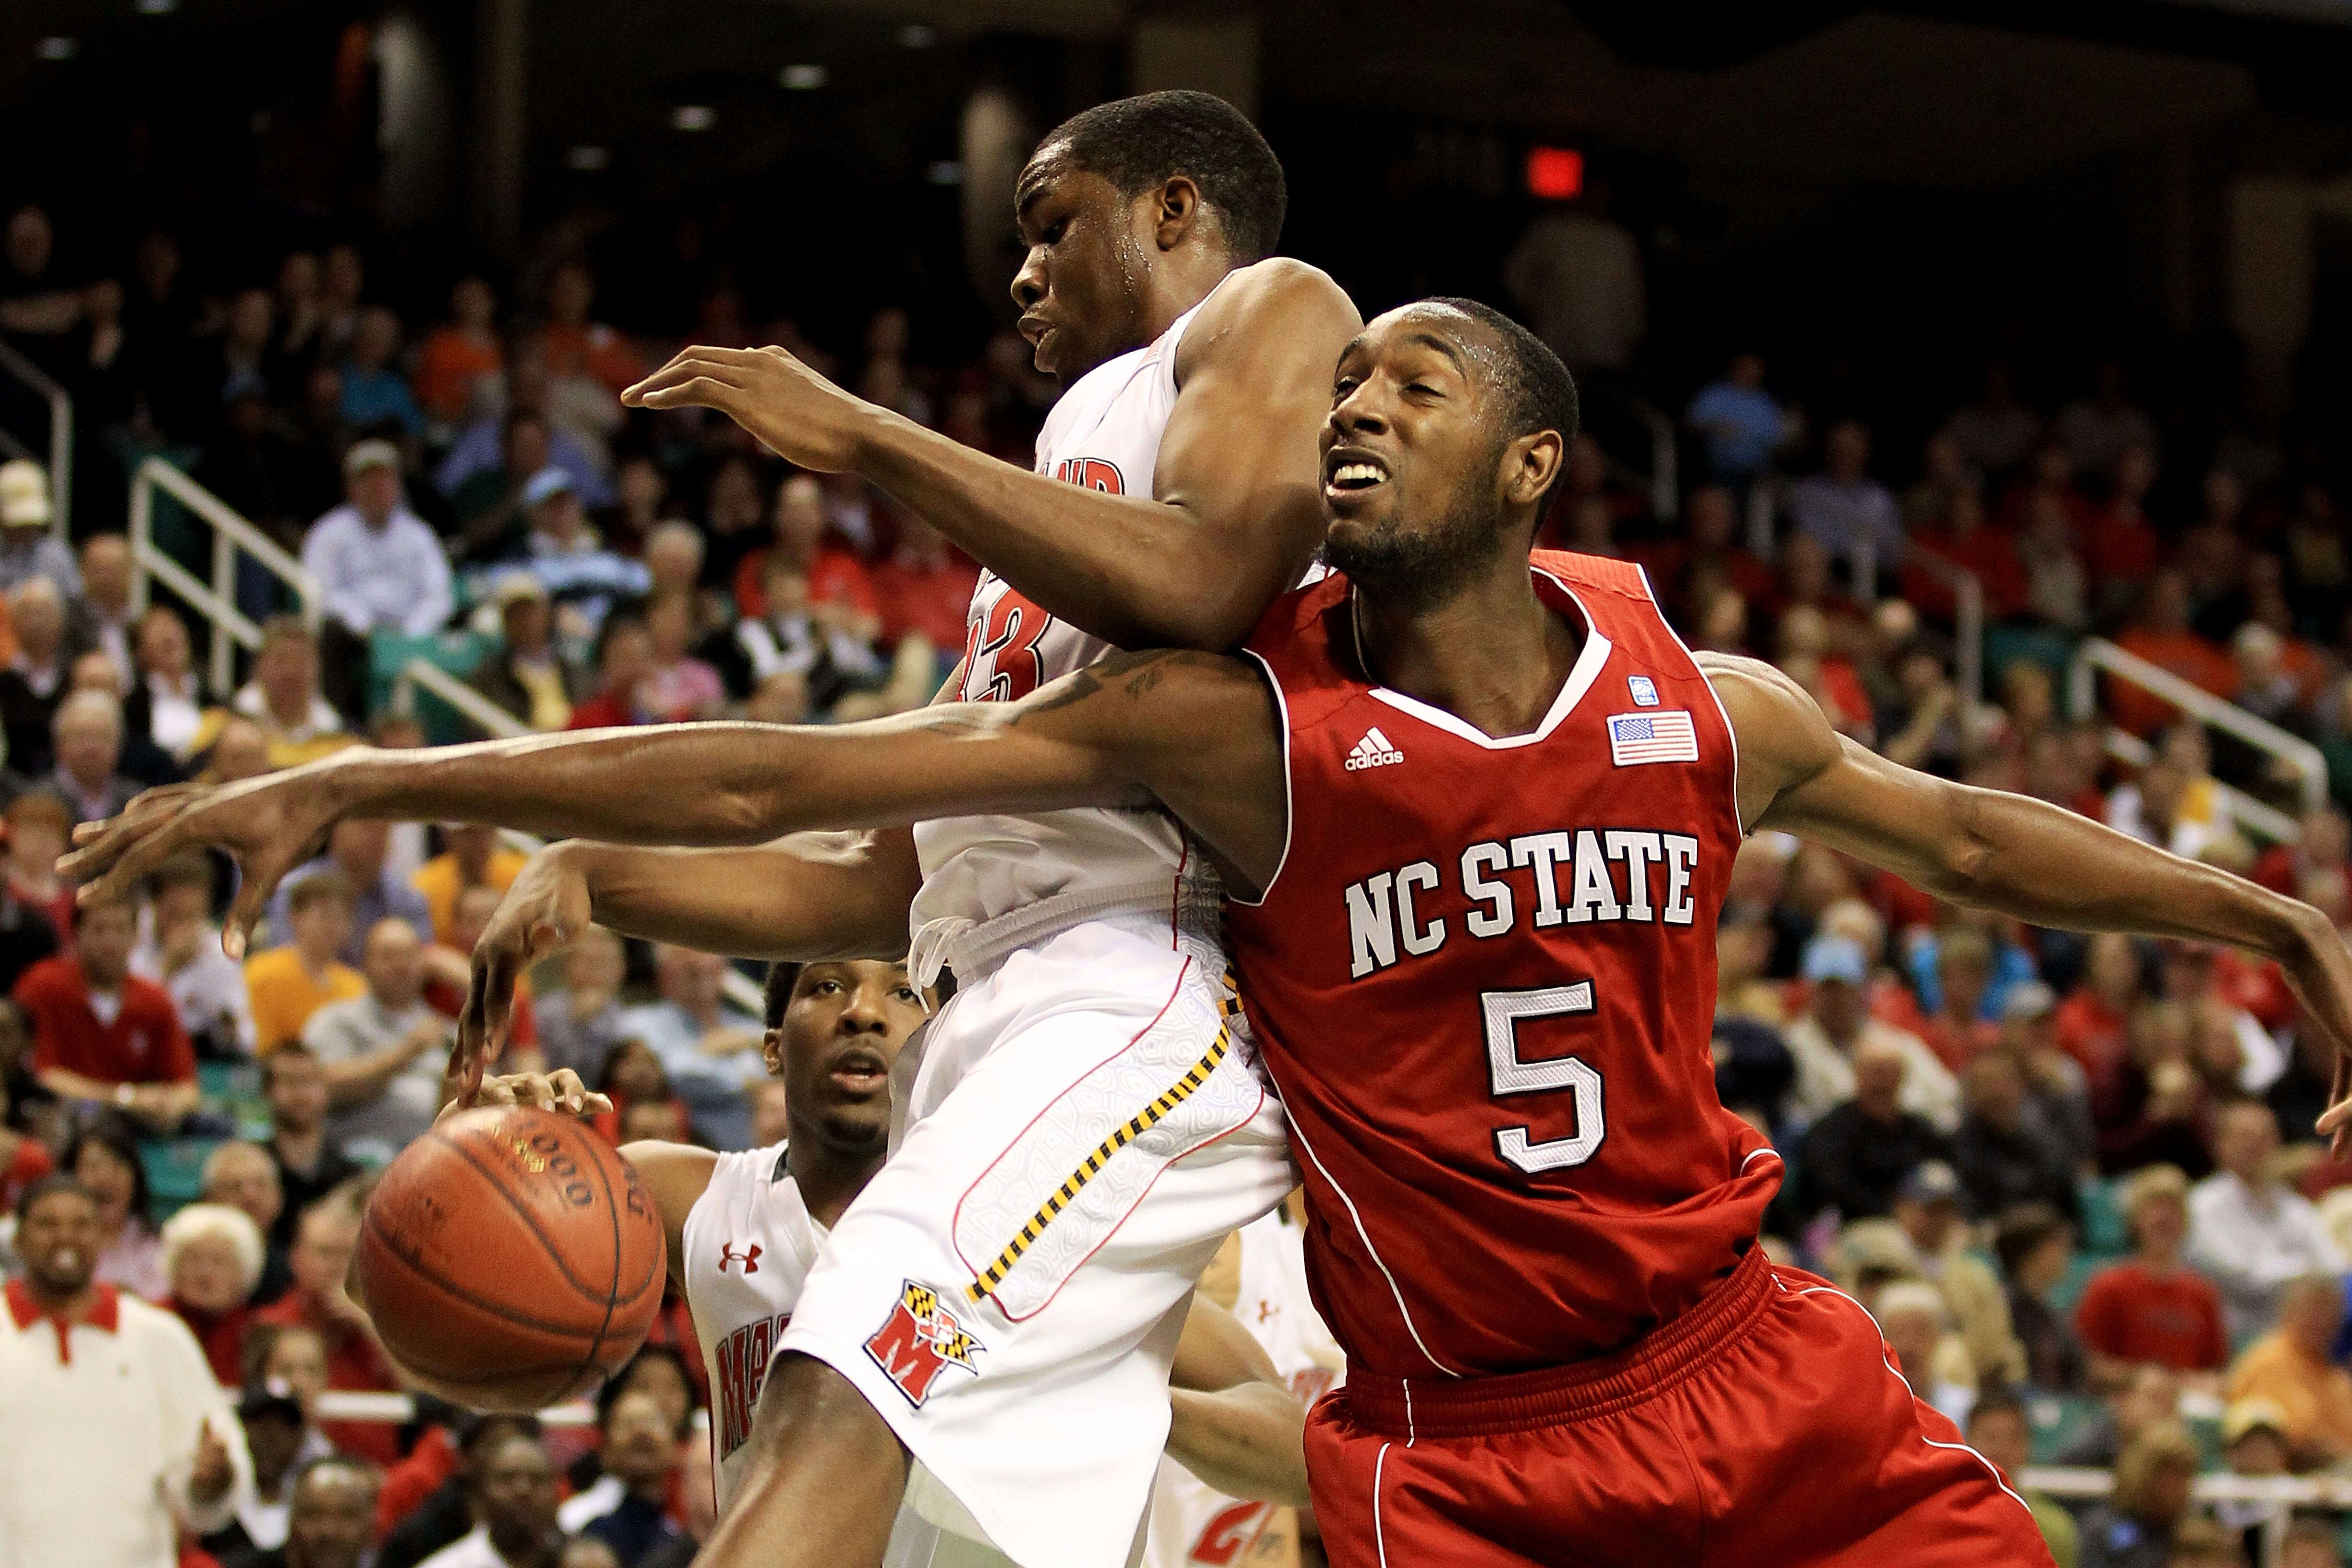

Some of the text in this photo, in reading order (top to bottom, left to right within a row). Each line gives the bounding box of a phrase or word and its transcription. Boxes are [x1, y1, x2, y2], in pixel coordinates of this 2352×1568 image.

[1345, 750, 1405, 772] adidas
[1344, 830, 1699, 979] NC STATE
[1480, 980, 1605, 1174] 5
[715, 1313, 792, 1463] MA
